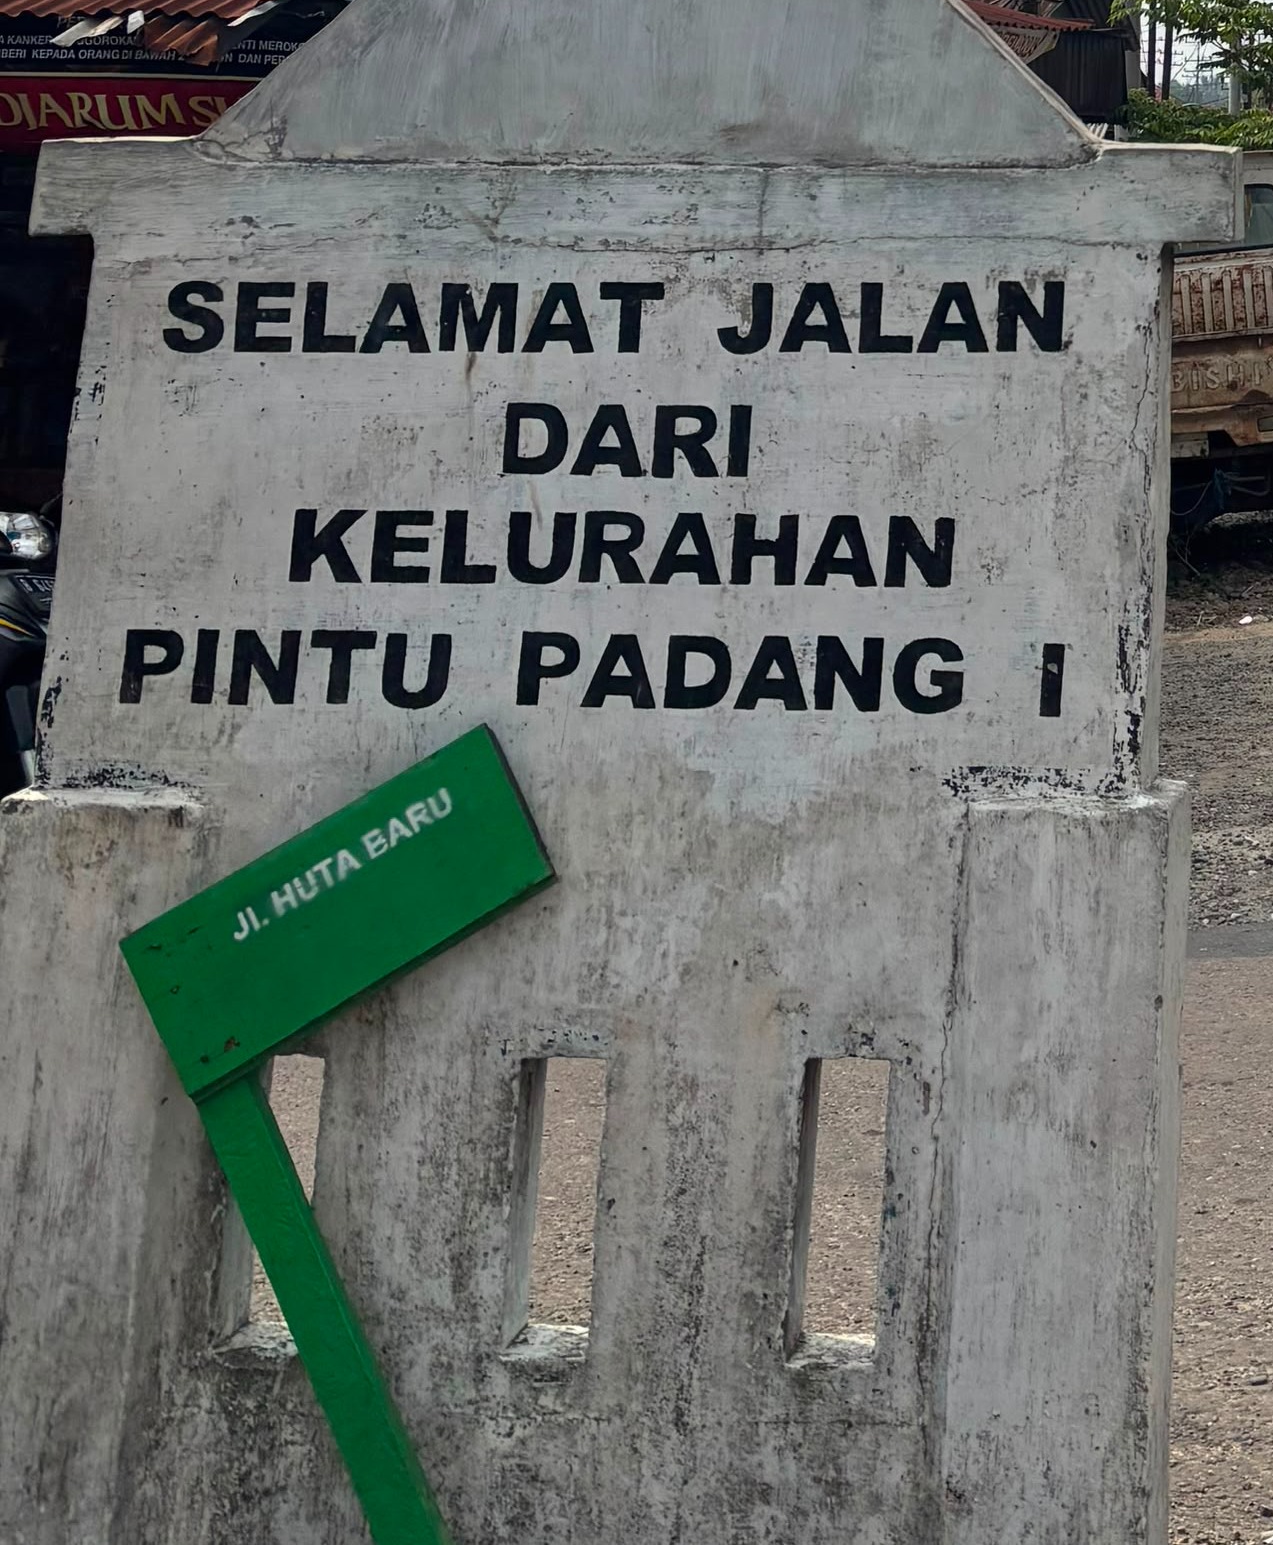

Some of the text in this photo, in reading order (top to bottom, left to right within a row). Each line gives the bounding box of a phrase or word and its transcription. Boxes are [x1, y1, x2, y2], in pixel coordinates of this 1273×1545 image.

[32, 49, 76, 60] KEPADA
[78, 49, 120, 60] ORANG
[238, 54, 262, 64] DAN
[162, 280, 1073, 355] SELAMAT JALAN
[502, 402, 753, 479] DARI
[288, 508, 956, 588] KELURAHAN
[119, 628, 1066, 718] PINTU PADANG I
[270, 848, 362, 917] HUTA
[360, 786, 453, 860] BARU
